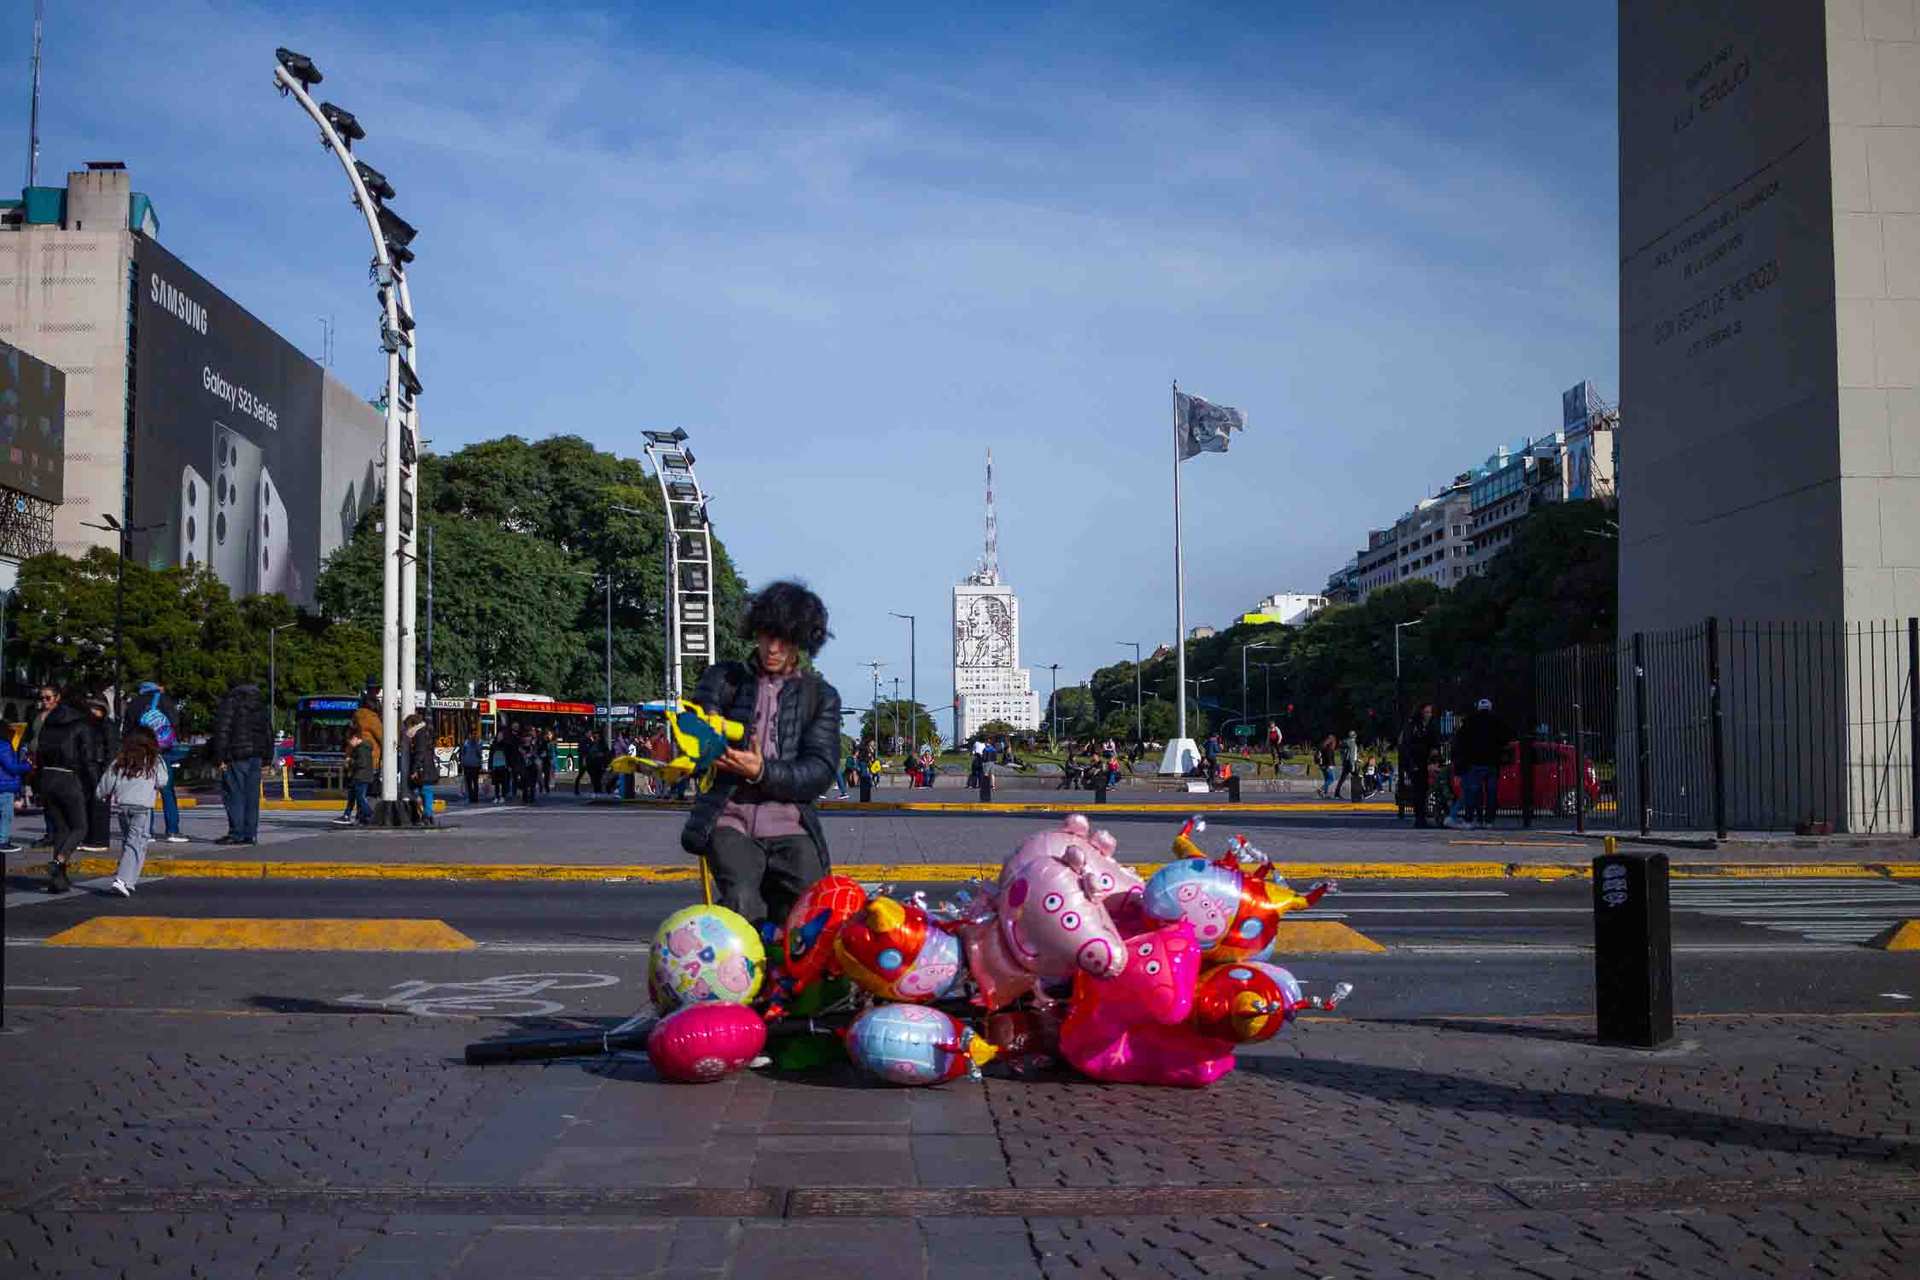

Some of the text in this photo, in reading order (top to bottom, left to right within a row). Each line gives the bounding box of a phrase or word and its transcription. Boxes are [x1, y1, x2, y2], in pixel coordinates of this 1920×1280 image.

[151, 273, 208, 335] SAMSUNG
[203, 366, 278, 430] Galaxy S23 Series
